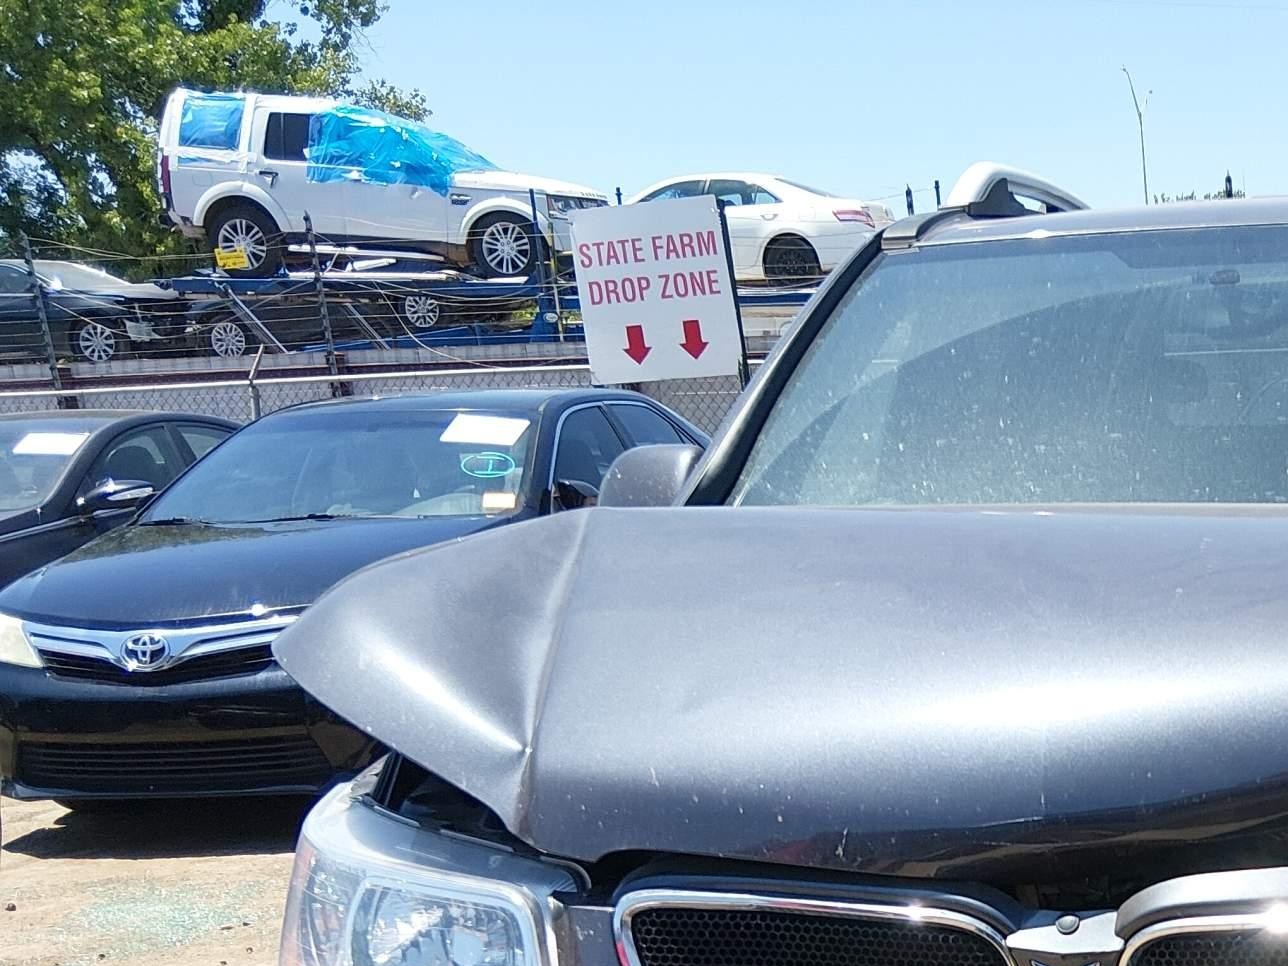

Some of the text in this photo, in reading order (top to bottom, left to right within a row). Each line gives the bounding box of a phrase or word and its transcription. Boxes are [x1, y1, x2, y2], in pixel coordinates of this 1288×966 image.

[578, 230, 718, 268] STATE FARM
[588, 270, 721, 306] DROP ZONE
